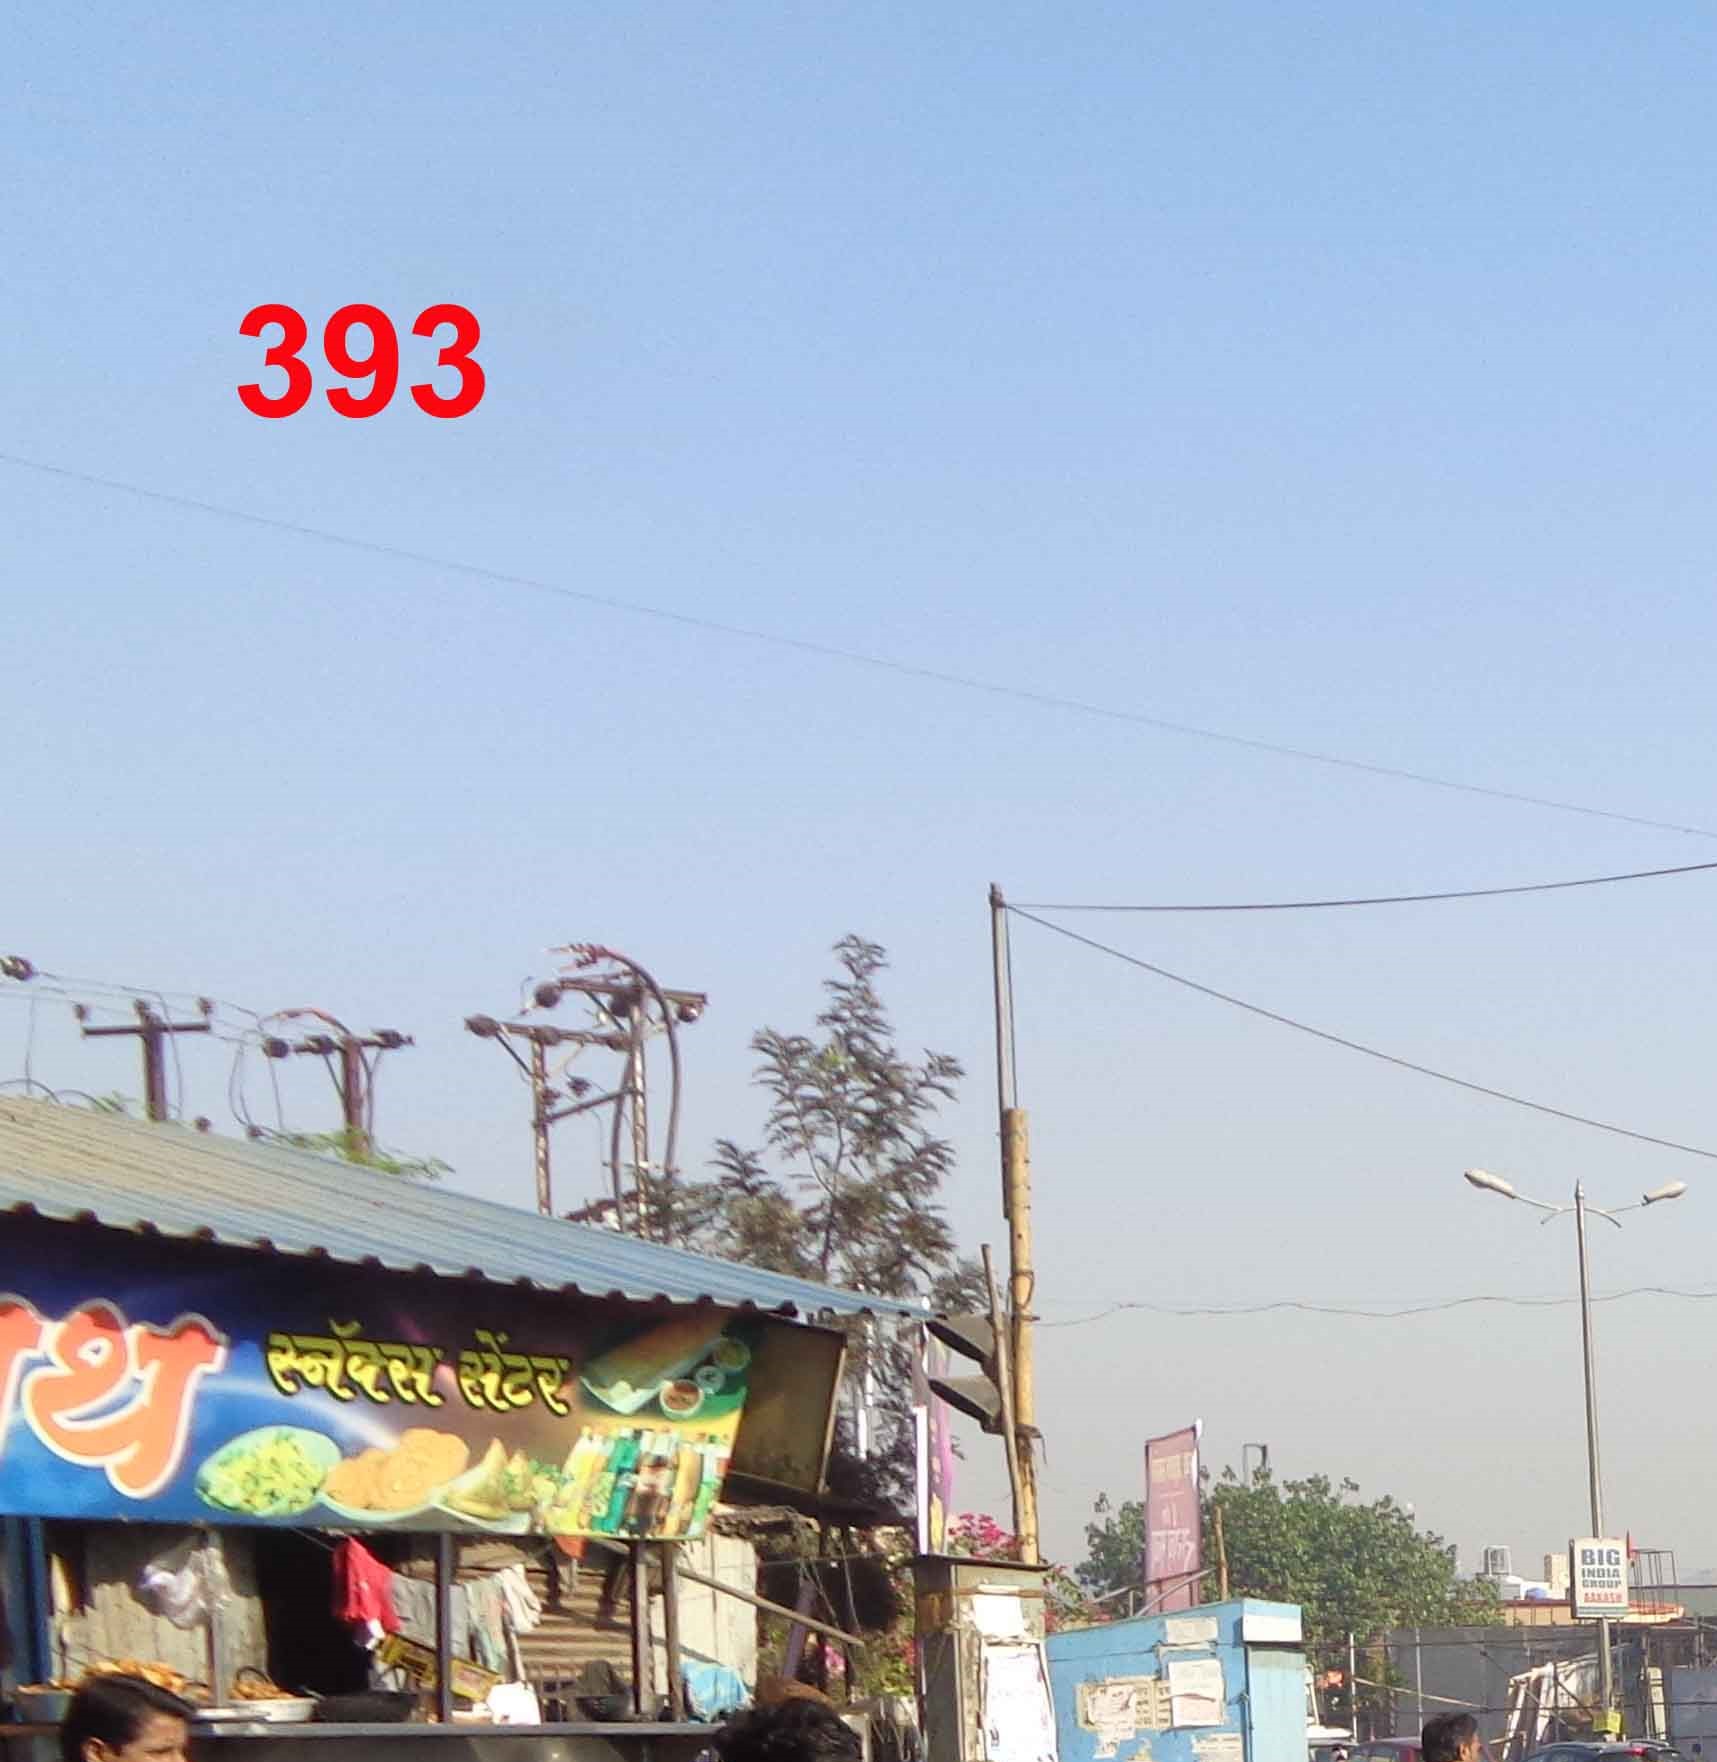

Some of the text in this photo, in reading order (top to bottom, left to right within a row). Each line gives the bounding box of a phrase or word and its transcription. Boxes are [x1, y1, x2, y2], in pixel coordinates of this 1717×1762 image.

[456, 1327, 573, 1416] सेंटर
[1582, 1548, 1620, 1565] BIG
[1582, 1568, 1620, 1578] INDIA
[1583, 1579, 1621, 1588] GROUP
